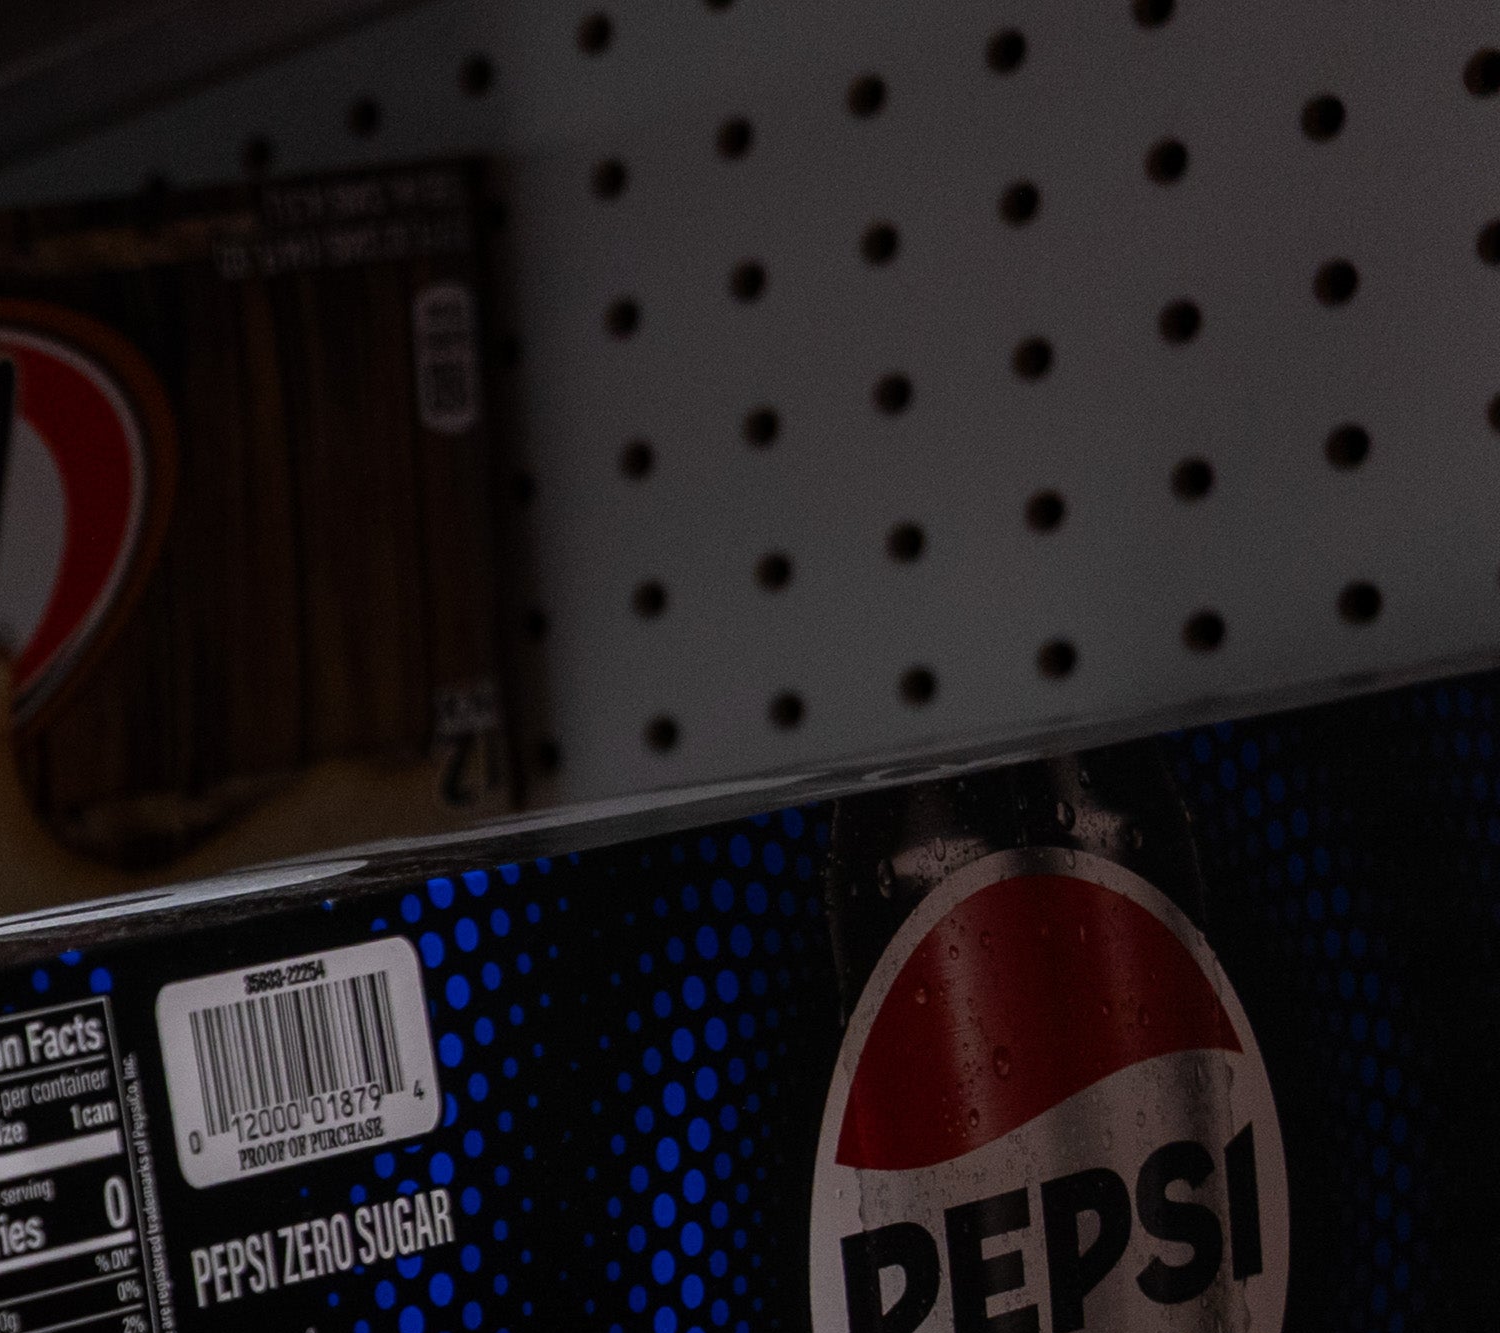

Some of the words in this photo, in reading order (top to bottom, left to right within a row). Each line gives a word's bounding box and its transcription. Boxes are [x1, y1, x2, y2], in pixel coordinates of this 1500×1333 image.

[25, 1013, 106, 1064] Facts
[239, 1142, 285, 1171] PROOF
[288, 1137, 307, 1162] OF
[309, 1116, 384, 1156] PURCHASE
[103, 1174, 131, 1229] 0
[191, 1230, 279, 1308] PEPSI
[278, 1212, 354, 1285] ZERO
[355, 1188, 456, 1265] SUGAR
